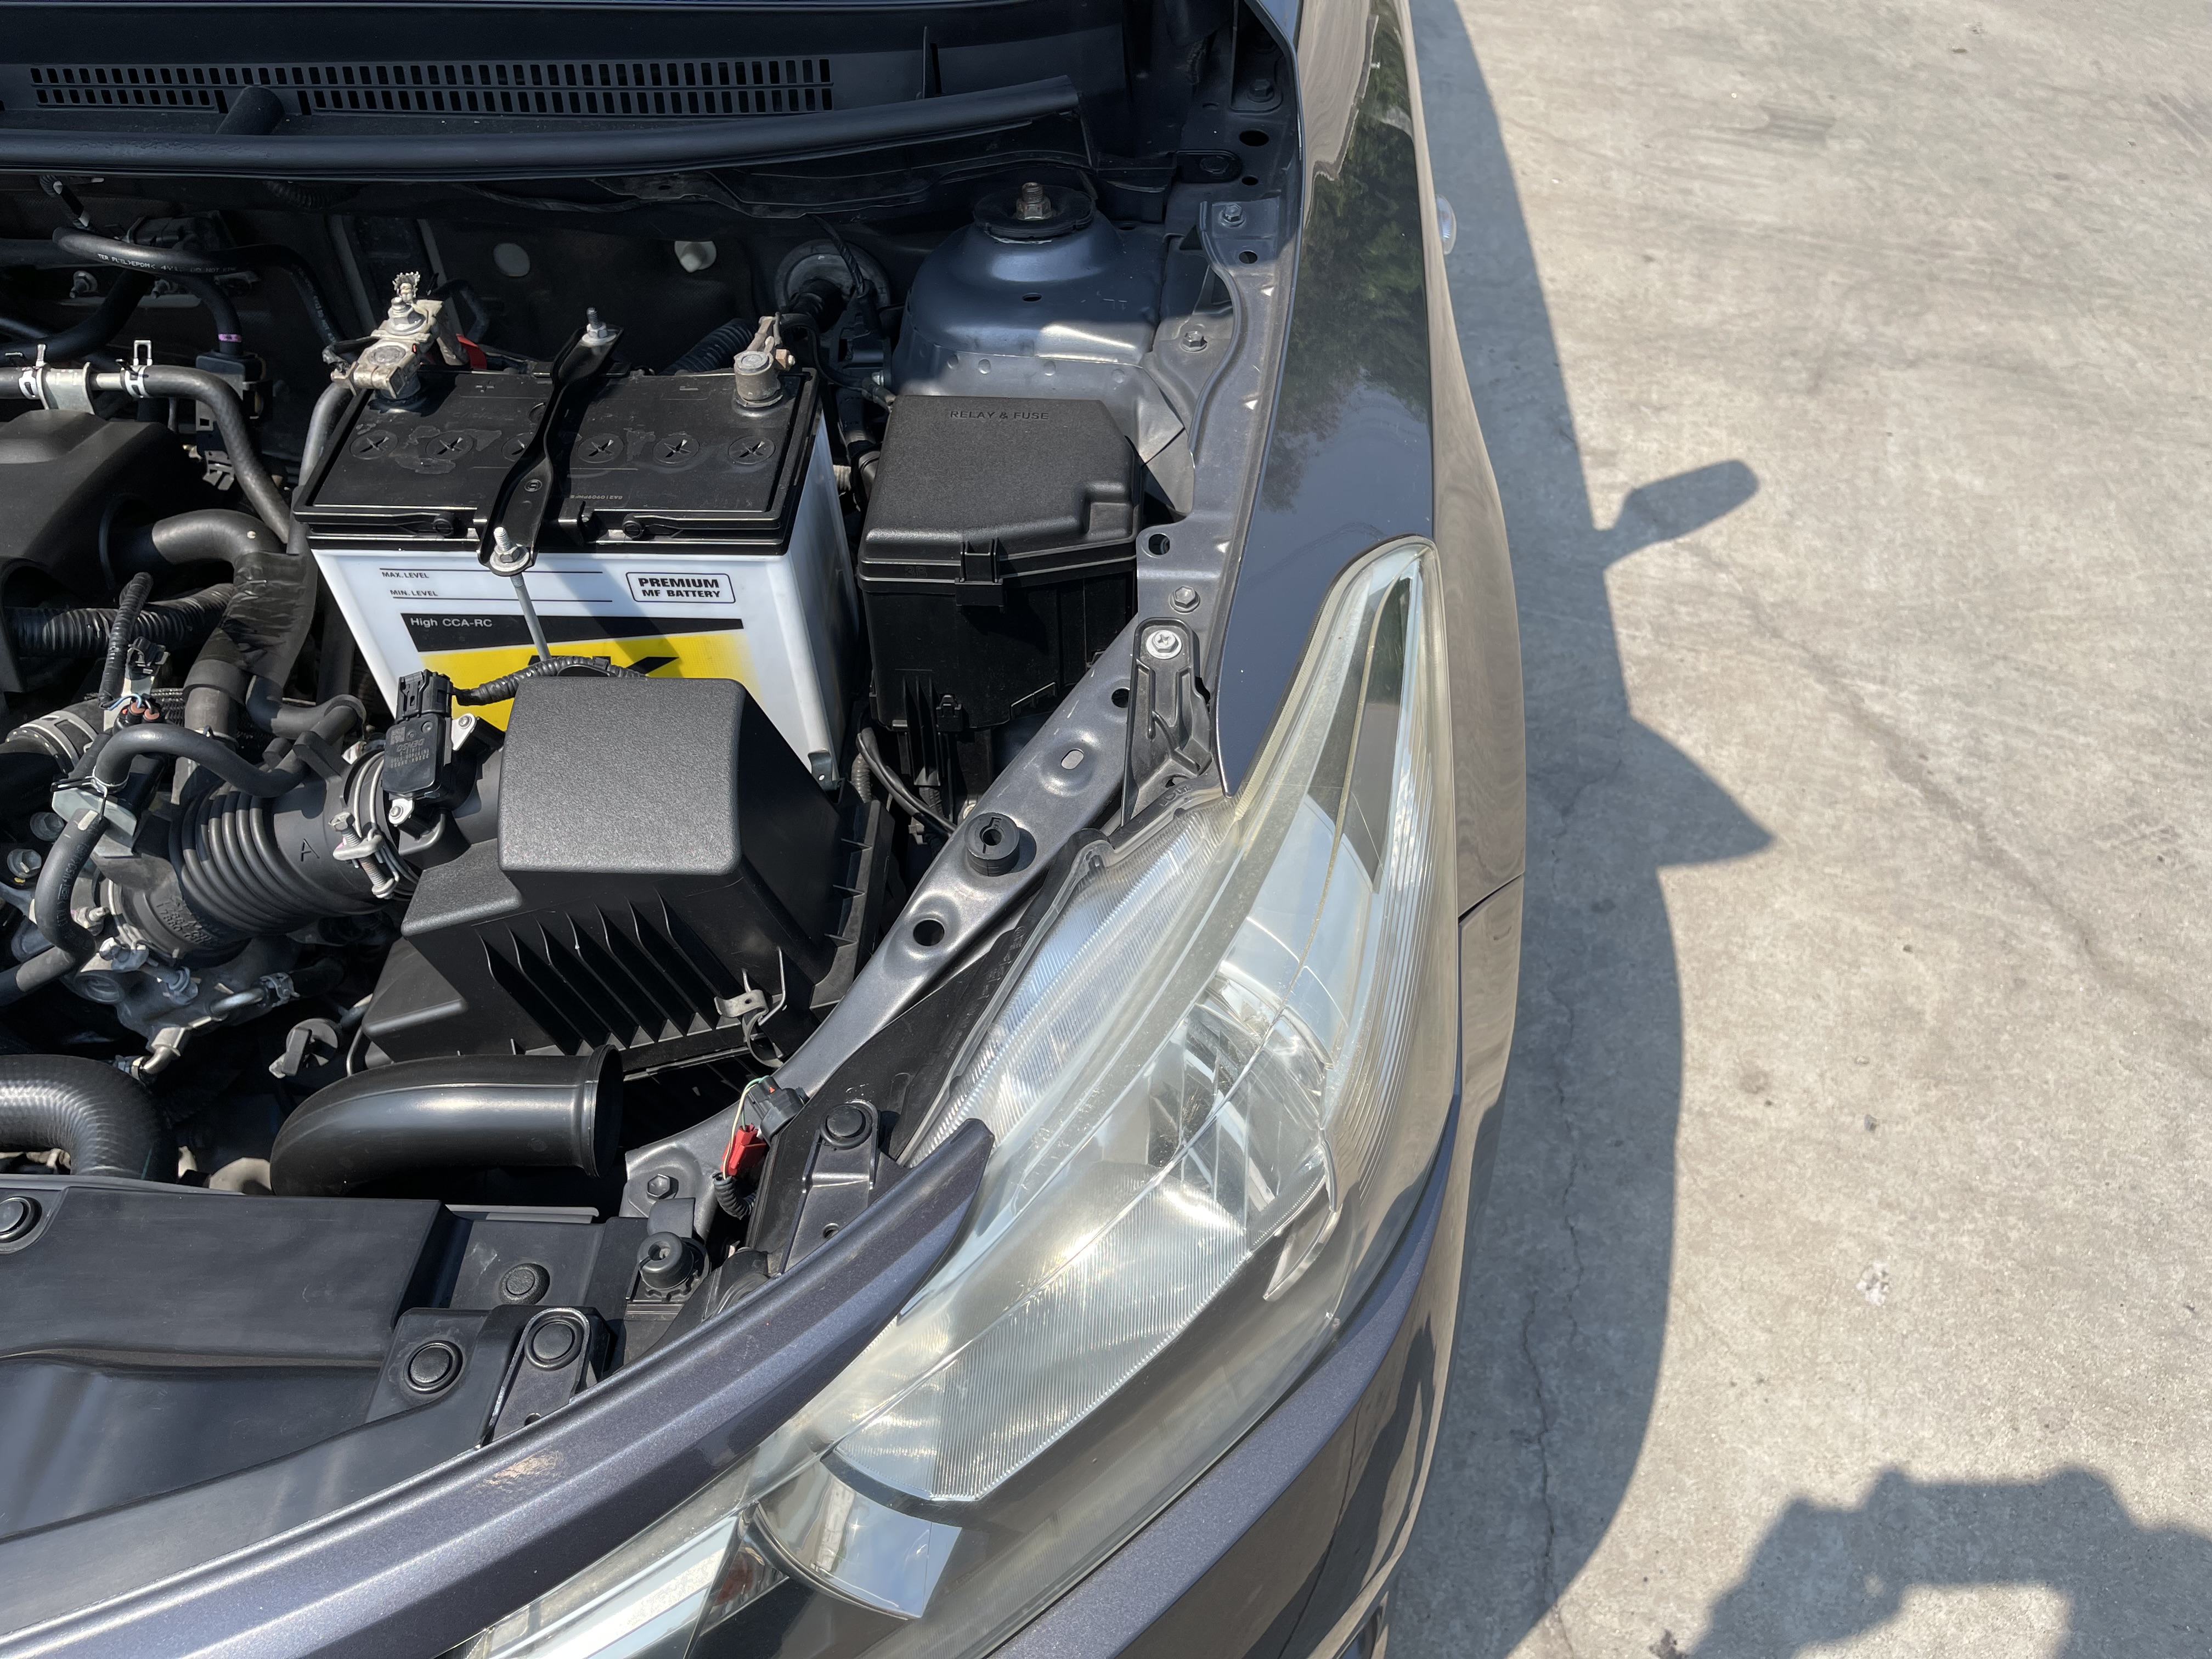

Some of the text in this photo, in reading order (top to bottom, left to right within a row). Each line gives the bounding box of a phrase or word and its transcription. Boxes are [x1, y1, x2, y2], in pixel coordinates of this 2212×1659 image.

[905, 566, 928, 578] 3B
[638, 578, 720, 588] PREMIUM
[410, 618, 493, 628] High CCA-RC
[397, 738, 425, 752] DENSO
[301, 838, 320, 862] A
